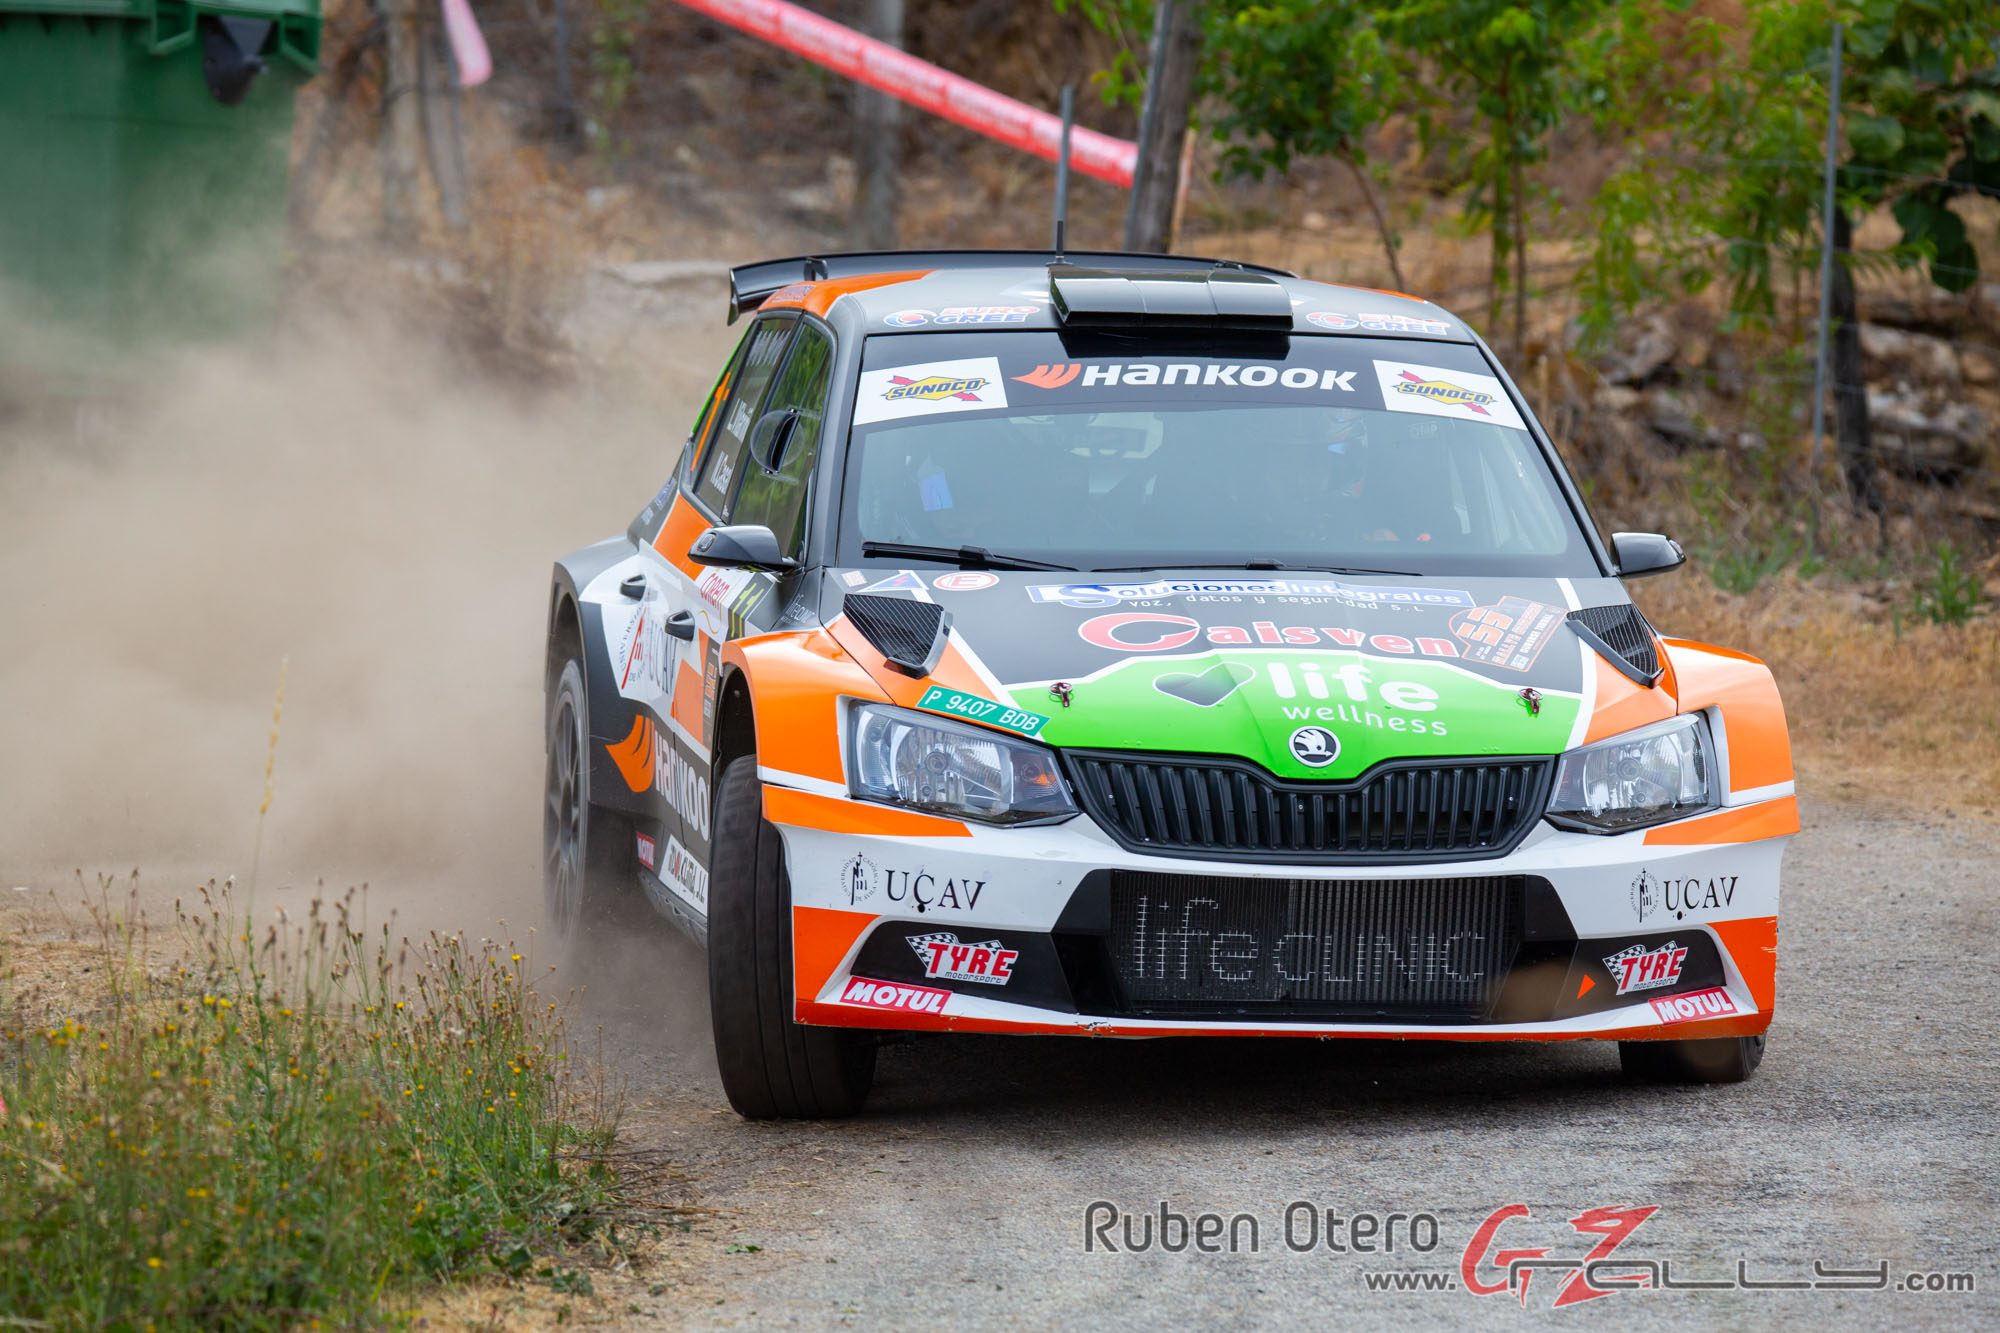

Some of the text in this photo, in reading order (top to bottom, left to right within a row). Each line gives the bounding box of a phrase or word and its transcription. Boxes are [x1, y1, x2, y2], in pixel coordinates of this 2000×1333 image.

[933, 313, 1029, 325] GREE
[940, 306, 1041, 316] EURO
[1360, 320, 1448, 335] GREE
[891, 379, 982, 400] SUNOCO
[1402, 383, 1491, 404] SUNOCO
[1185, 594, 1243, 603] datos
[1254, 596, 1266, 604] y
[1278, 596, 1378, 610] seguridad
[1078, 613, 1460, 658] Caisven
[1267, 662, 1439, 712] life
[924, 690, 1040, 732] P 9407 BDB
[1282, 704, 1448, 736] wellness
[1663, 876, 1739, 911] UCAV
[1136, 896, 1259, 981] life
[927, 942, 1017, 978] TYRE
[1619, 950, 1687, 991] TYRE
[945, 971, 1003, 984] motorsport
[1633, 977, 1676, 991] motorsport
[844, 980, 945, 1013] MOTUL
[1655, 991, 1734, 1023] MOTUL
